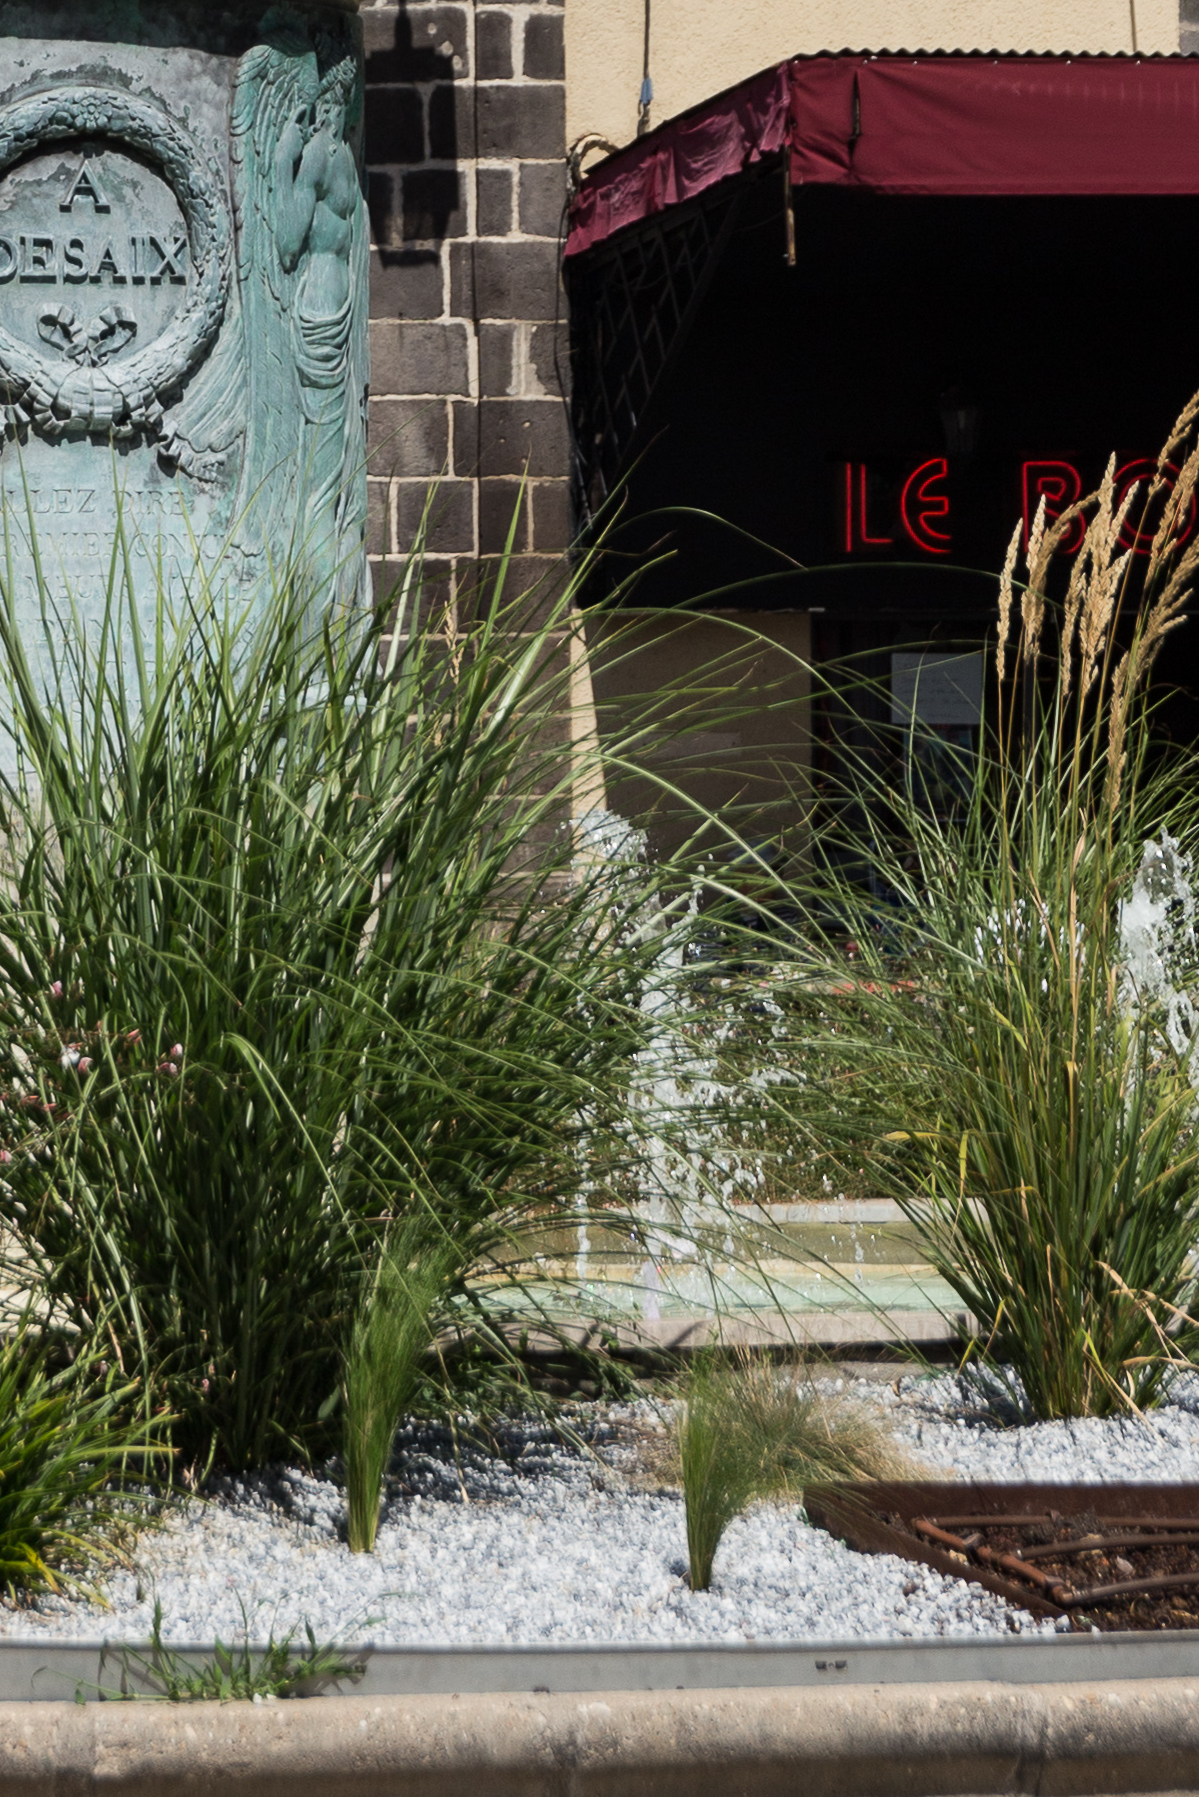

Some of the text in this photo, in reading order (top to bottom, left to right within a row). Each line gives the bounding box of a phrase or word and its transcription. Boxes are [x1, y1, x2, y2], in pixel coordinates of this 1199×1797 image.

[59, 159, 111, 214] A
[112, 489, 186, 515] DIRE
[846, 458, 950, 553] LE
